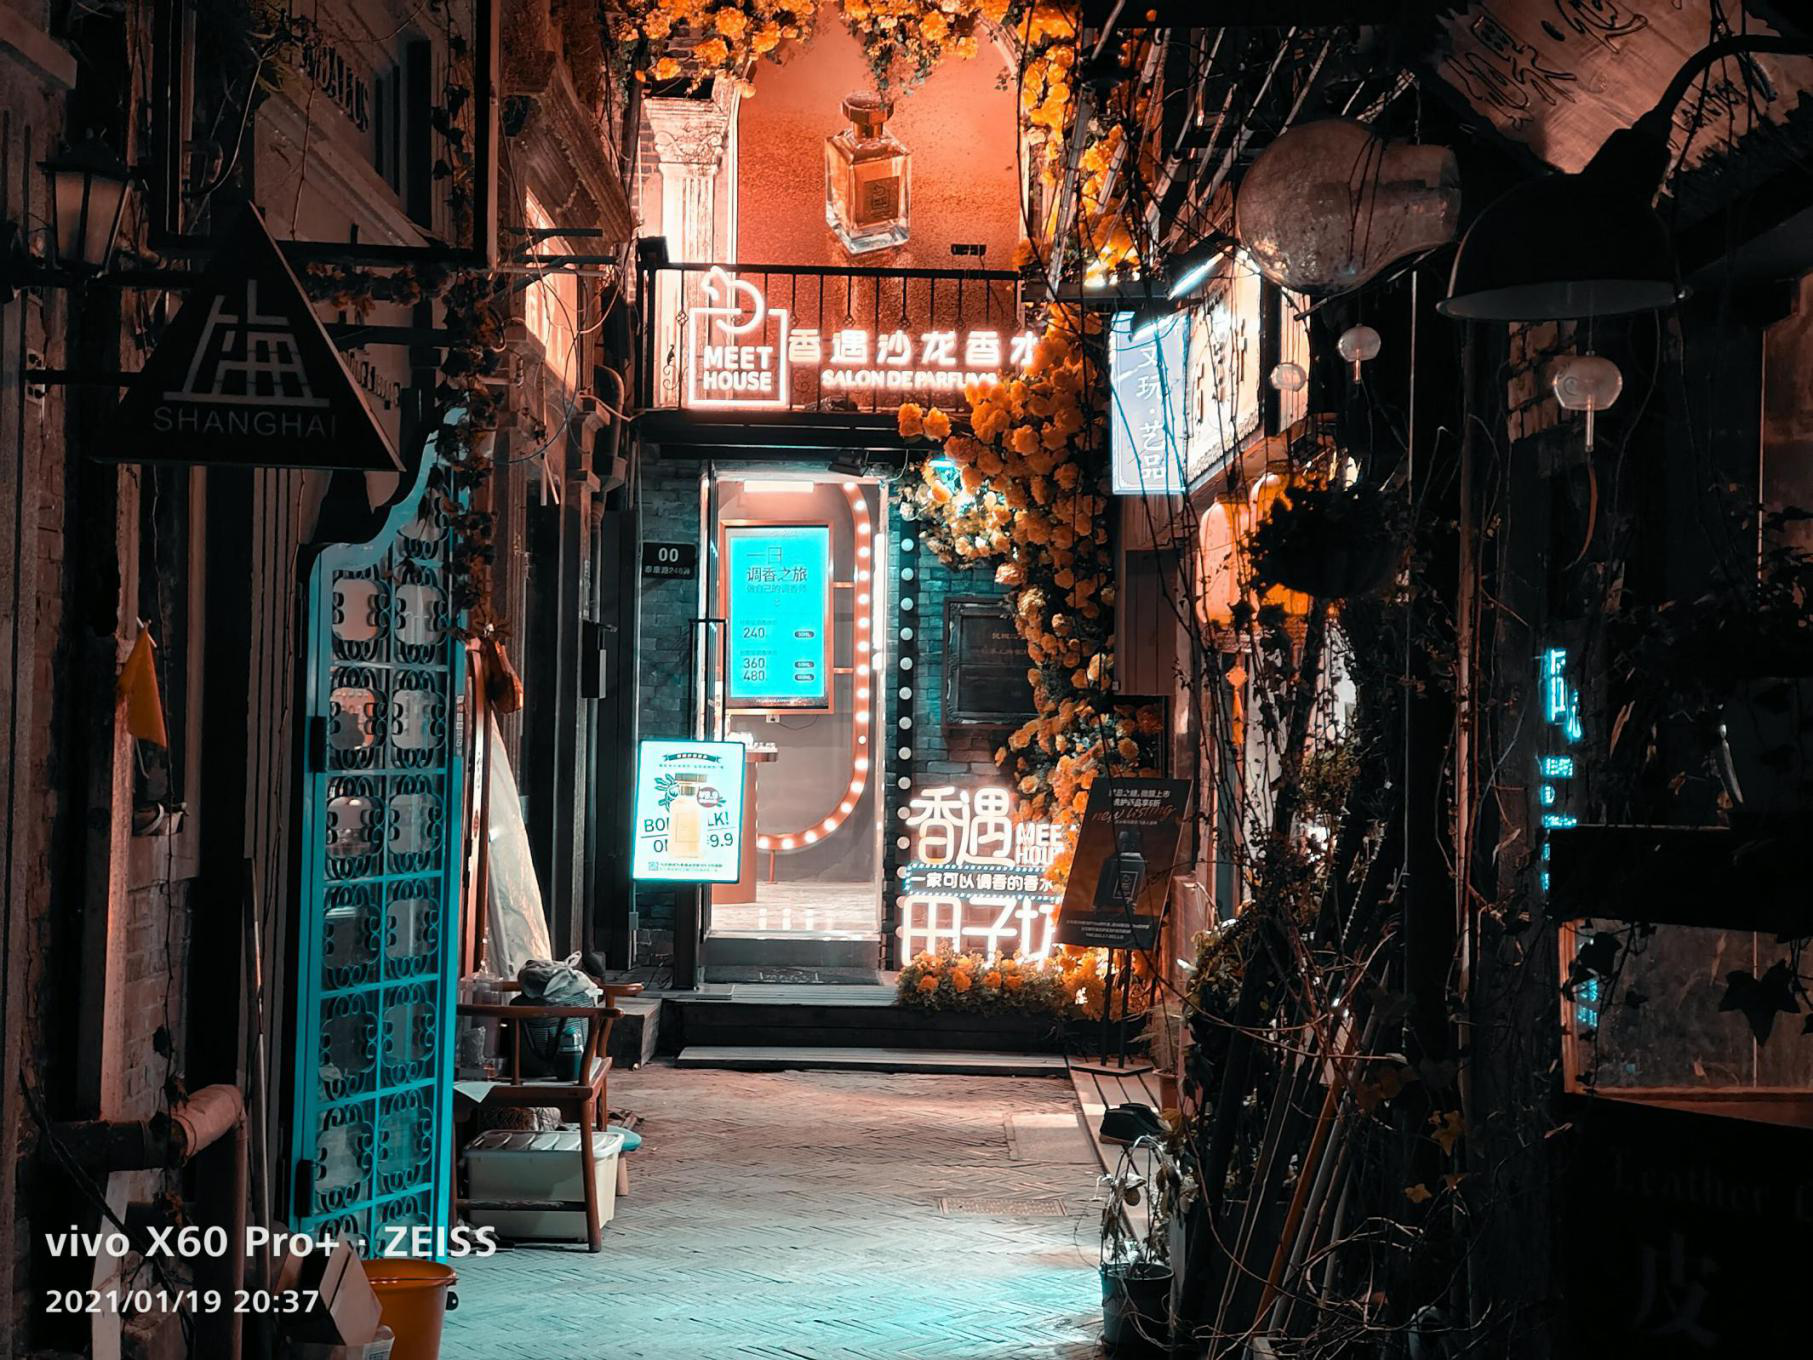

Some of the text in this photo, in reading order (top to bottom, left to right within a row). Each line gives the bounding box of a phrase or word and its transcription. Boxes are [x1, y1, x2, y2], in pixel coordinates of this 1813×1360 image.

[703, 345, 773, 369] MEET
[788, 329, 1039, 366] 香遇沙龙香水
[703, 370, 773, 391] HOUSE
[821, 369, 885, 388] SALON
[886, 371, 912, 388] DE
[152, 405, 336, 440] SHANGHAI
[659, 547, 679, 563] 00
[746, 566, 808, 582] 调香之旅
[743, 626, 766, 639] 240
[743, 657, 766, 669] 360
[743, 670, 766, 682] 480
[906, 786, 1016, 866] 香遇
[1015, 822, 1078, 847] MEE
